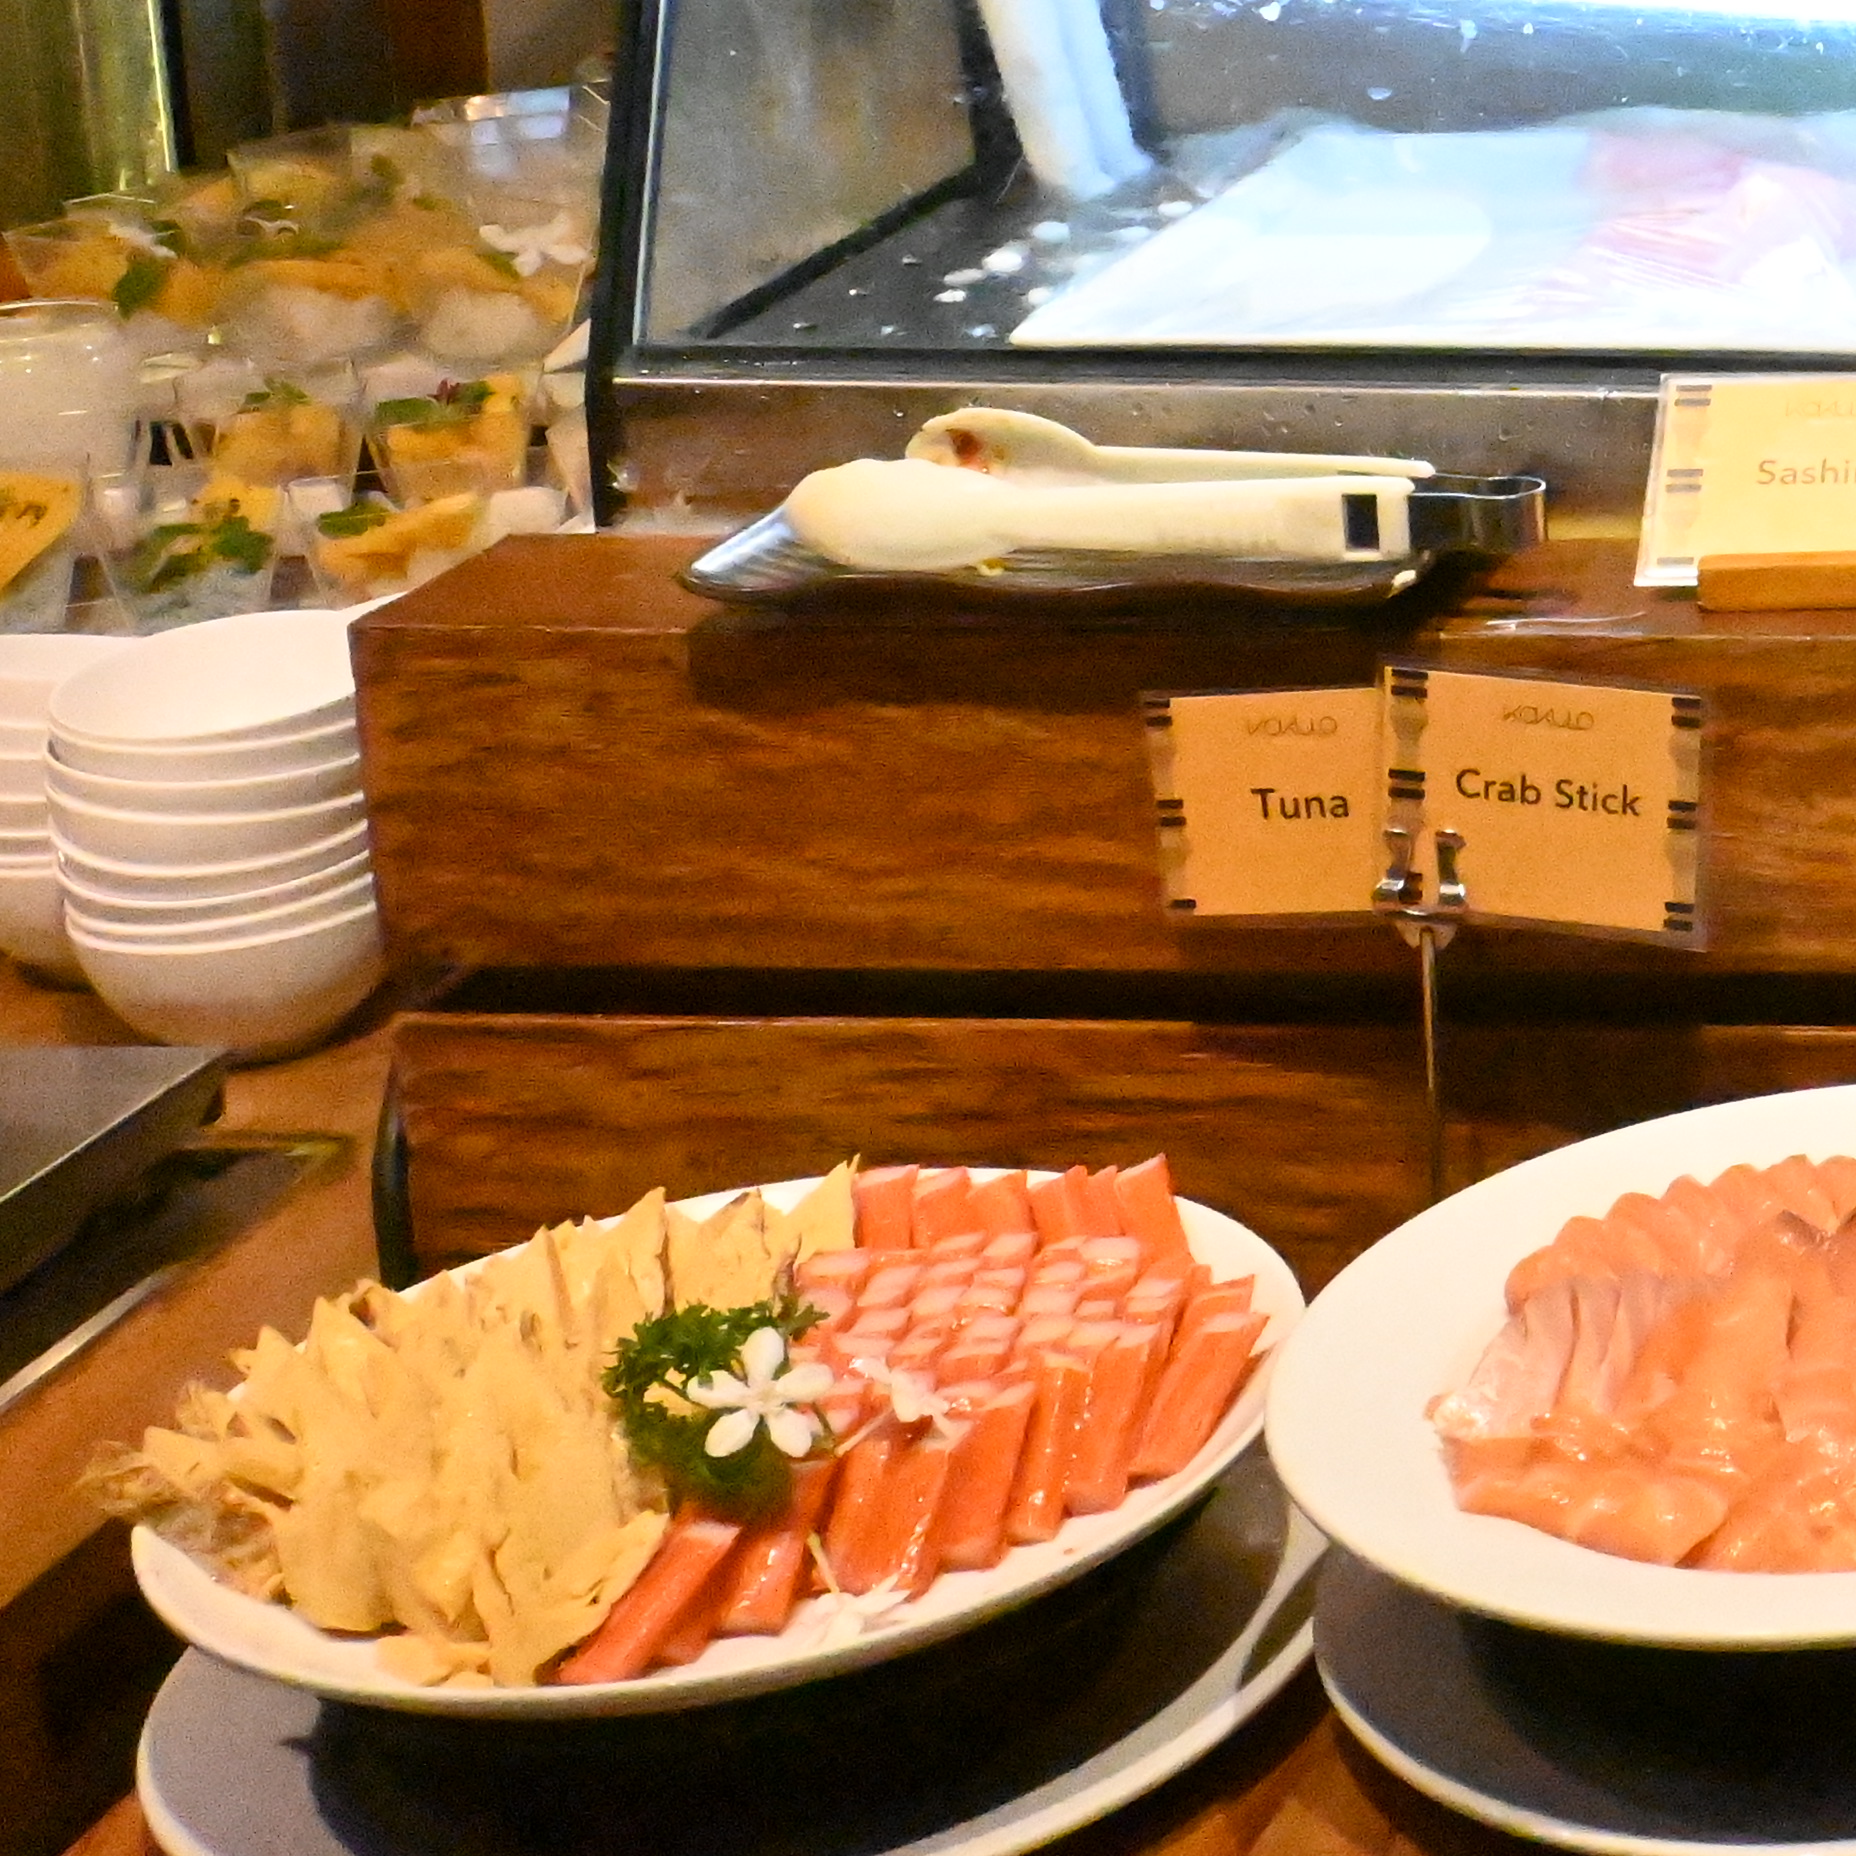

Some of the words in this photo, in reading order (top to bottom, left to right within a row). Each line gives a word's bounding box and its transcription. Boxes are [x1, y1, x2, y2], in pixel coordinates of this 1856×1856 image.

[1250, 787, 1351, 821] Tuna
[1455, 767, 1542, 807] Crab
[1555, 778, 1641, 818] Stick
